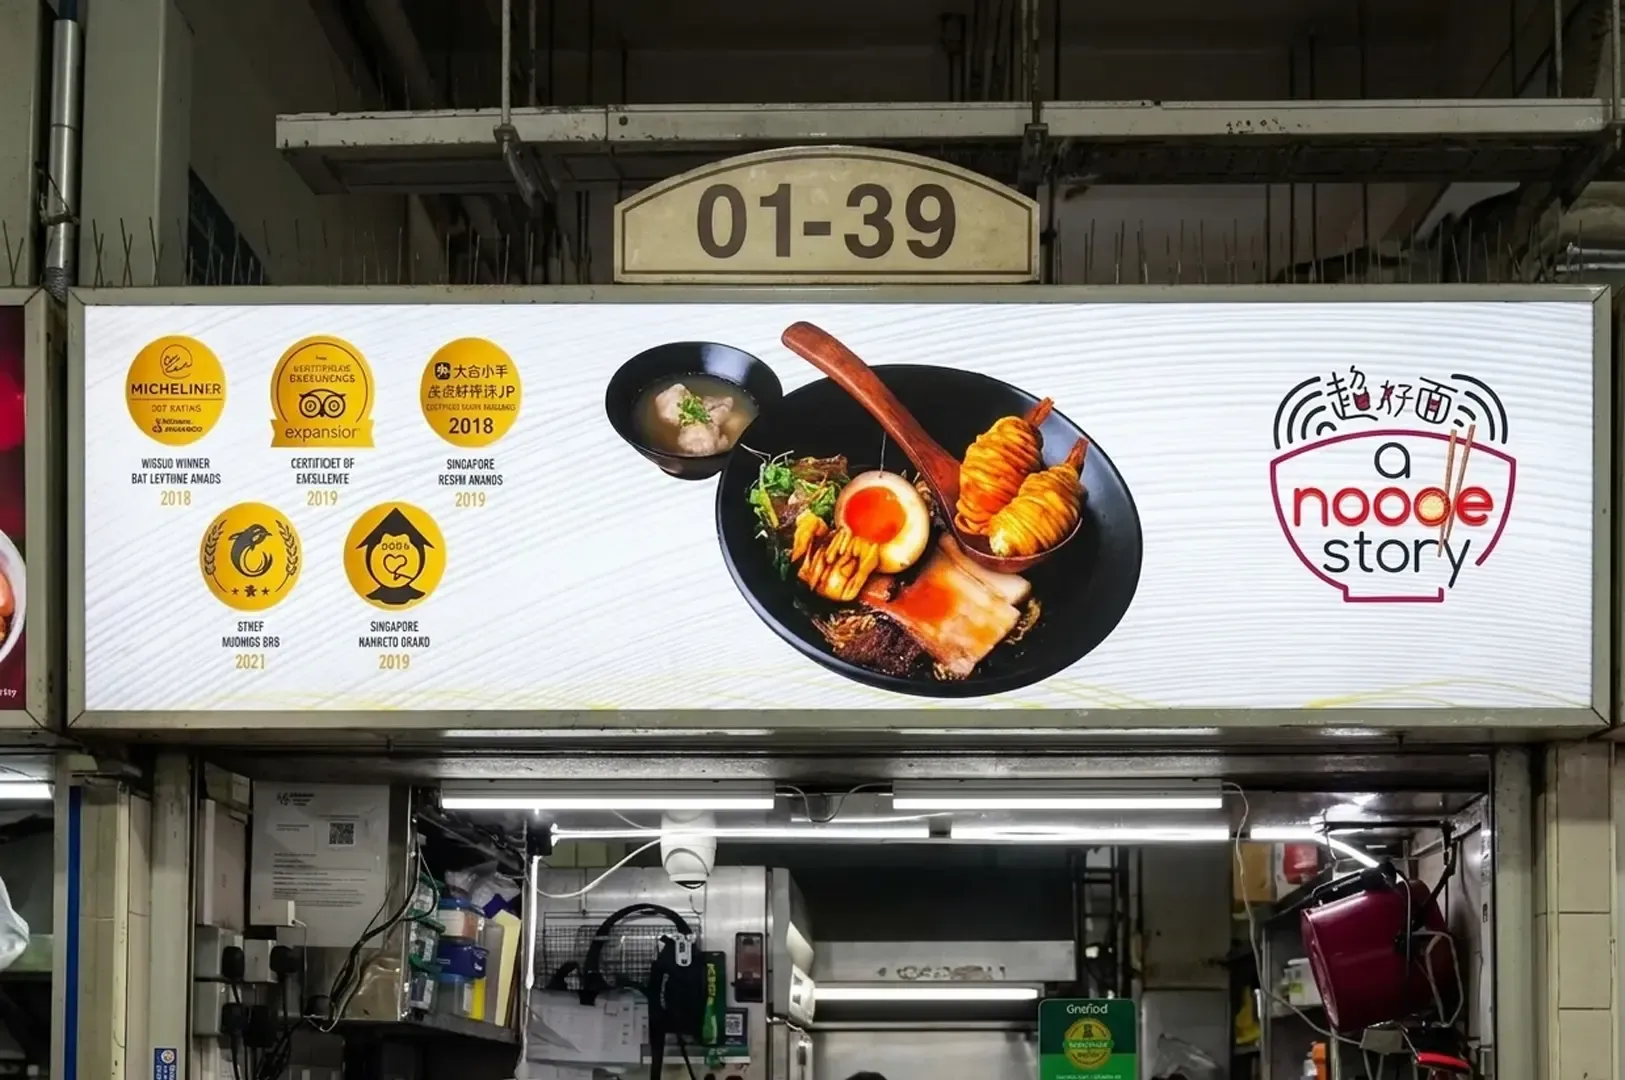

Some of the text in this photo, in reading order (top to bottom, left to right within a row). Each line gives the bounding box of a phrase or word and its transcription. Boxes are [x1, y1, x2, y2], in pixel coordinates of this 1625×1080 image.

[697, 183, 956, 259] 01-39
[448, 417, 494, 435] 2018
[176, 458, 210, 469] WINNER
[1374, 442, 1411, 479] a
[160, 490, 192, 506] 2018
[307, 490, 338, 506] 2019
[455, 491, 486, 508] 2019
[1323, 531, 1471, 589] story
[235, 653, 265, 670] 2021
[379, 653, 411, 670] 2019
